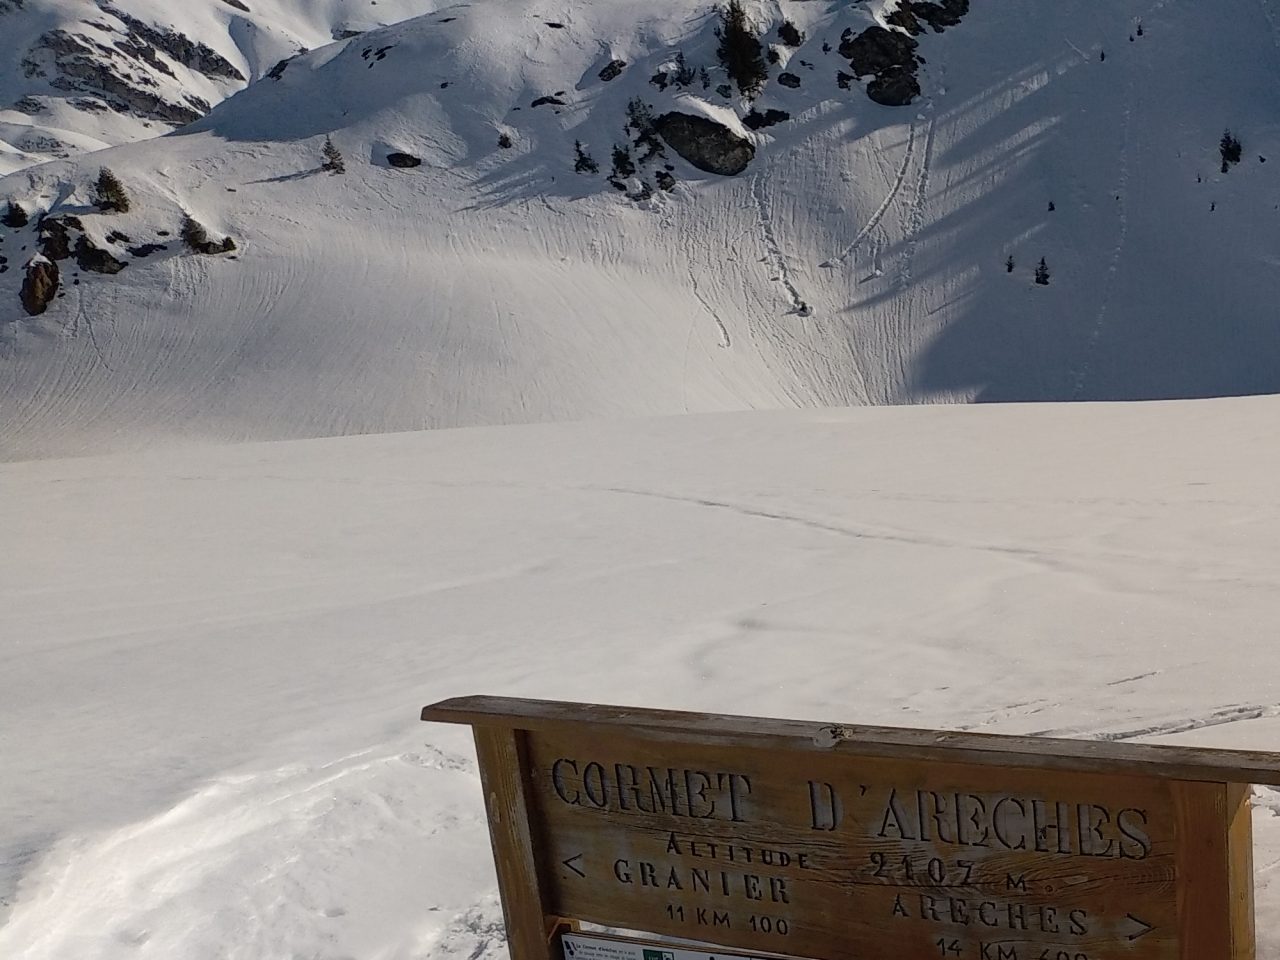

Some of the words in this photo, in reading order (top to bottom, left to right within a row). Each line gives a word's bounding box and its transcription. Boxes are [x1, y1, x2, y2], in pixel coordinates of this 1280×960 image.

[551, 757, 751, 823] CORMET
[666, 831, 810, 869] ALTITUDE
[870, 852, 977, 886] 2107
[613, 858, 790, 904] GRANIER
[892, 894, 1088, 936] ARECHES
[666, 904, 686, 923] 11
[696, 907, 731, 928] KM
[750, 914, 790, 936] 100
[937, 937, 963, 957] 14
